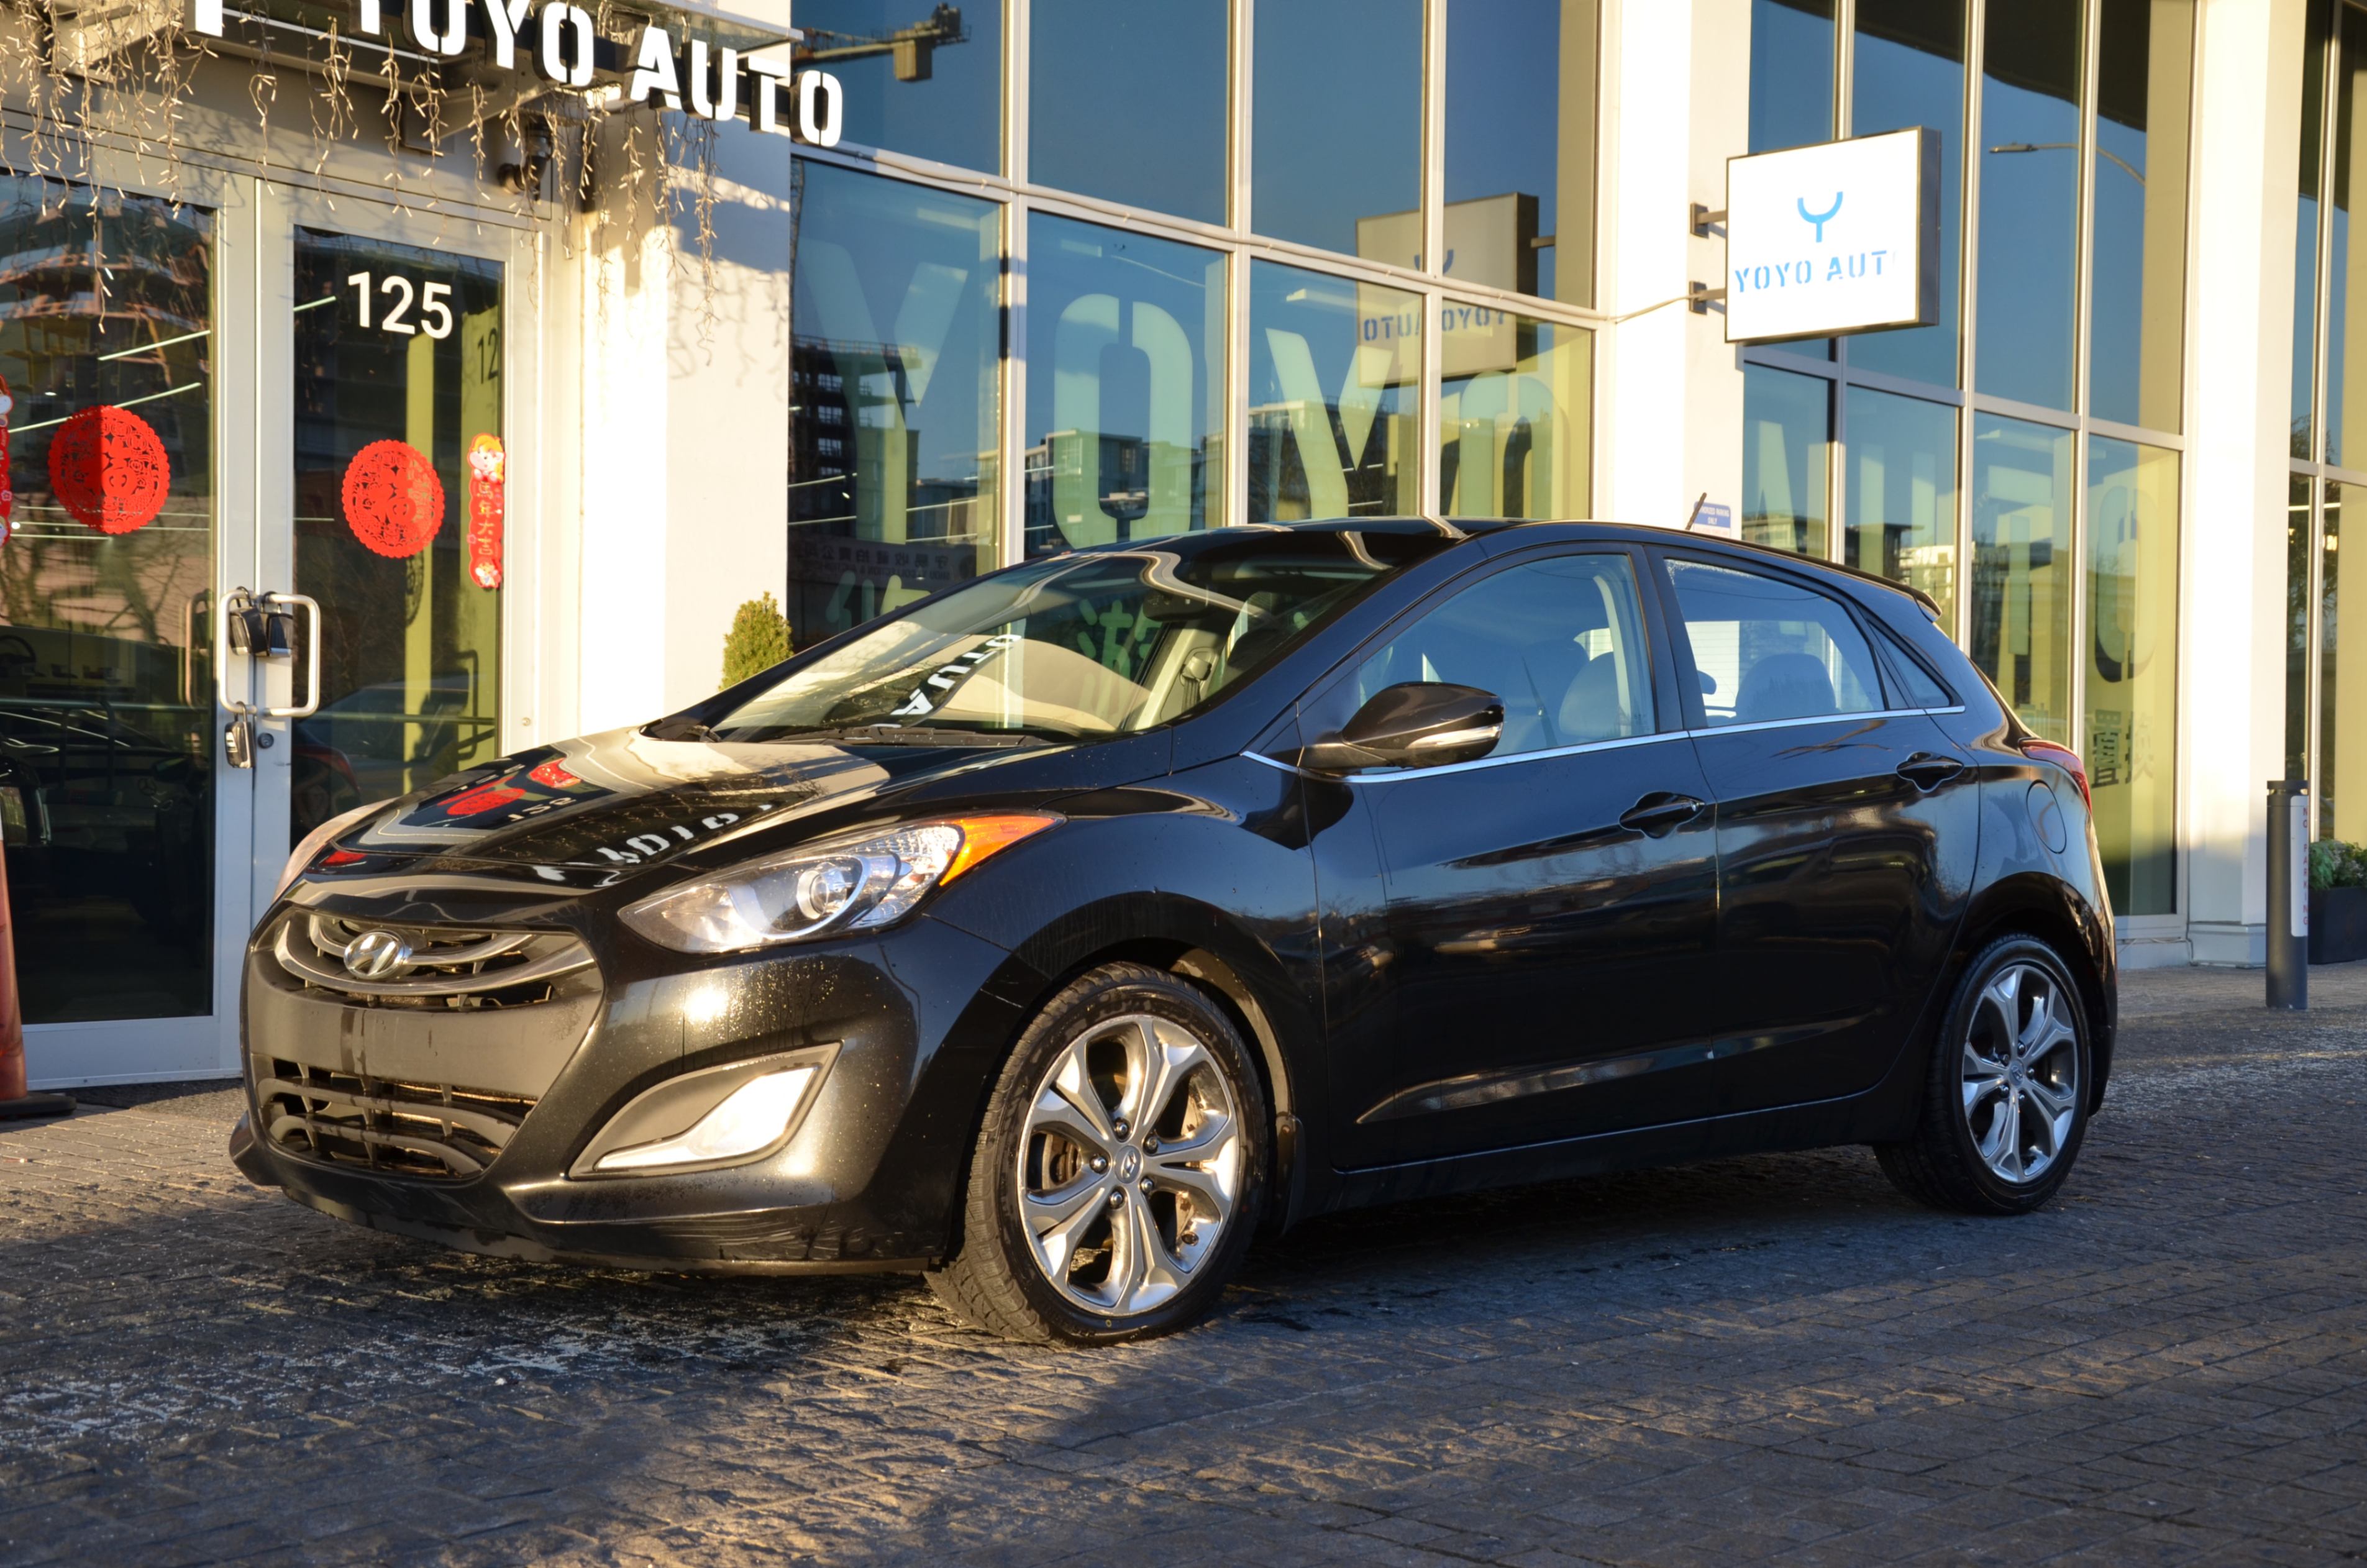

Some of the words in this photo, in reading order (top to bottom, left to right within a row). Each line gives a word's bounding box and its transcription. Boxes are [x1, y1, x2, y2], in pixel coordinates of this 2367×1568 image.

[629, 26, 844, 147] AUTO
[347, 271, 453, 340] 125
[1735, 260, 1812, 293] YOYO
[1827, 250, 1897, 281] AUT
